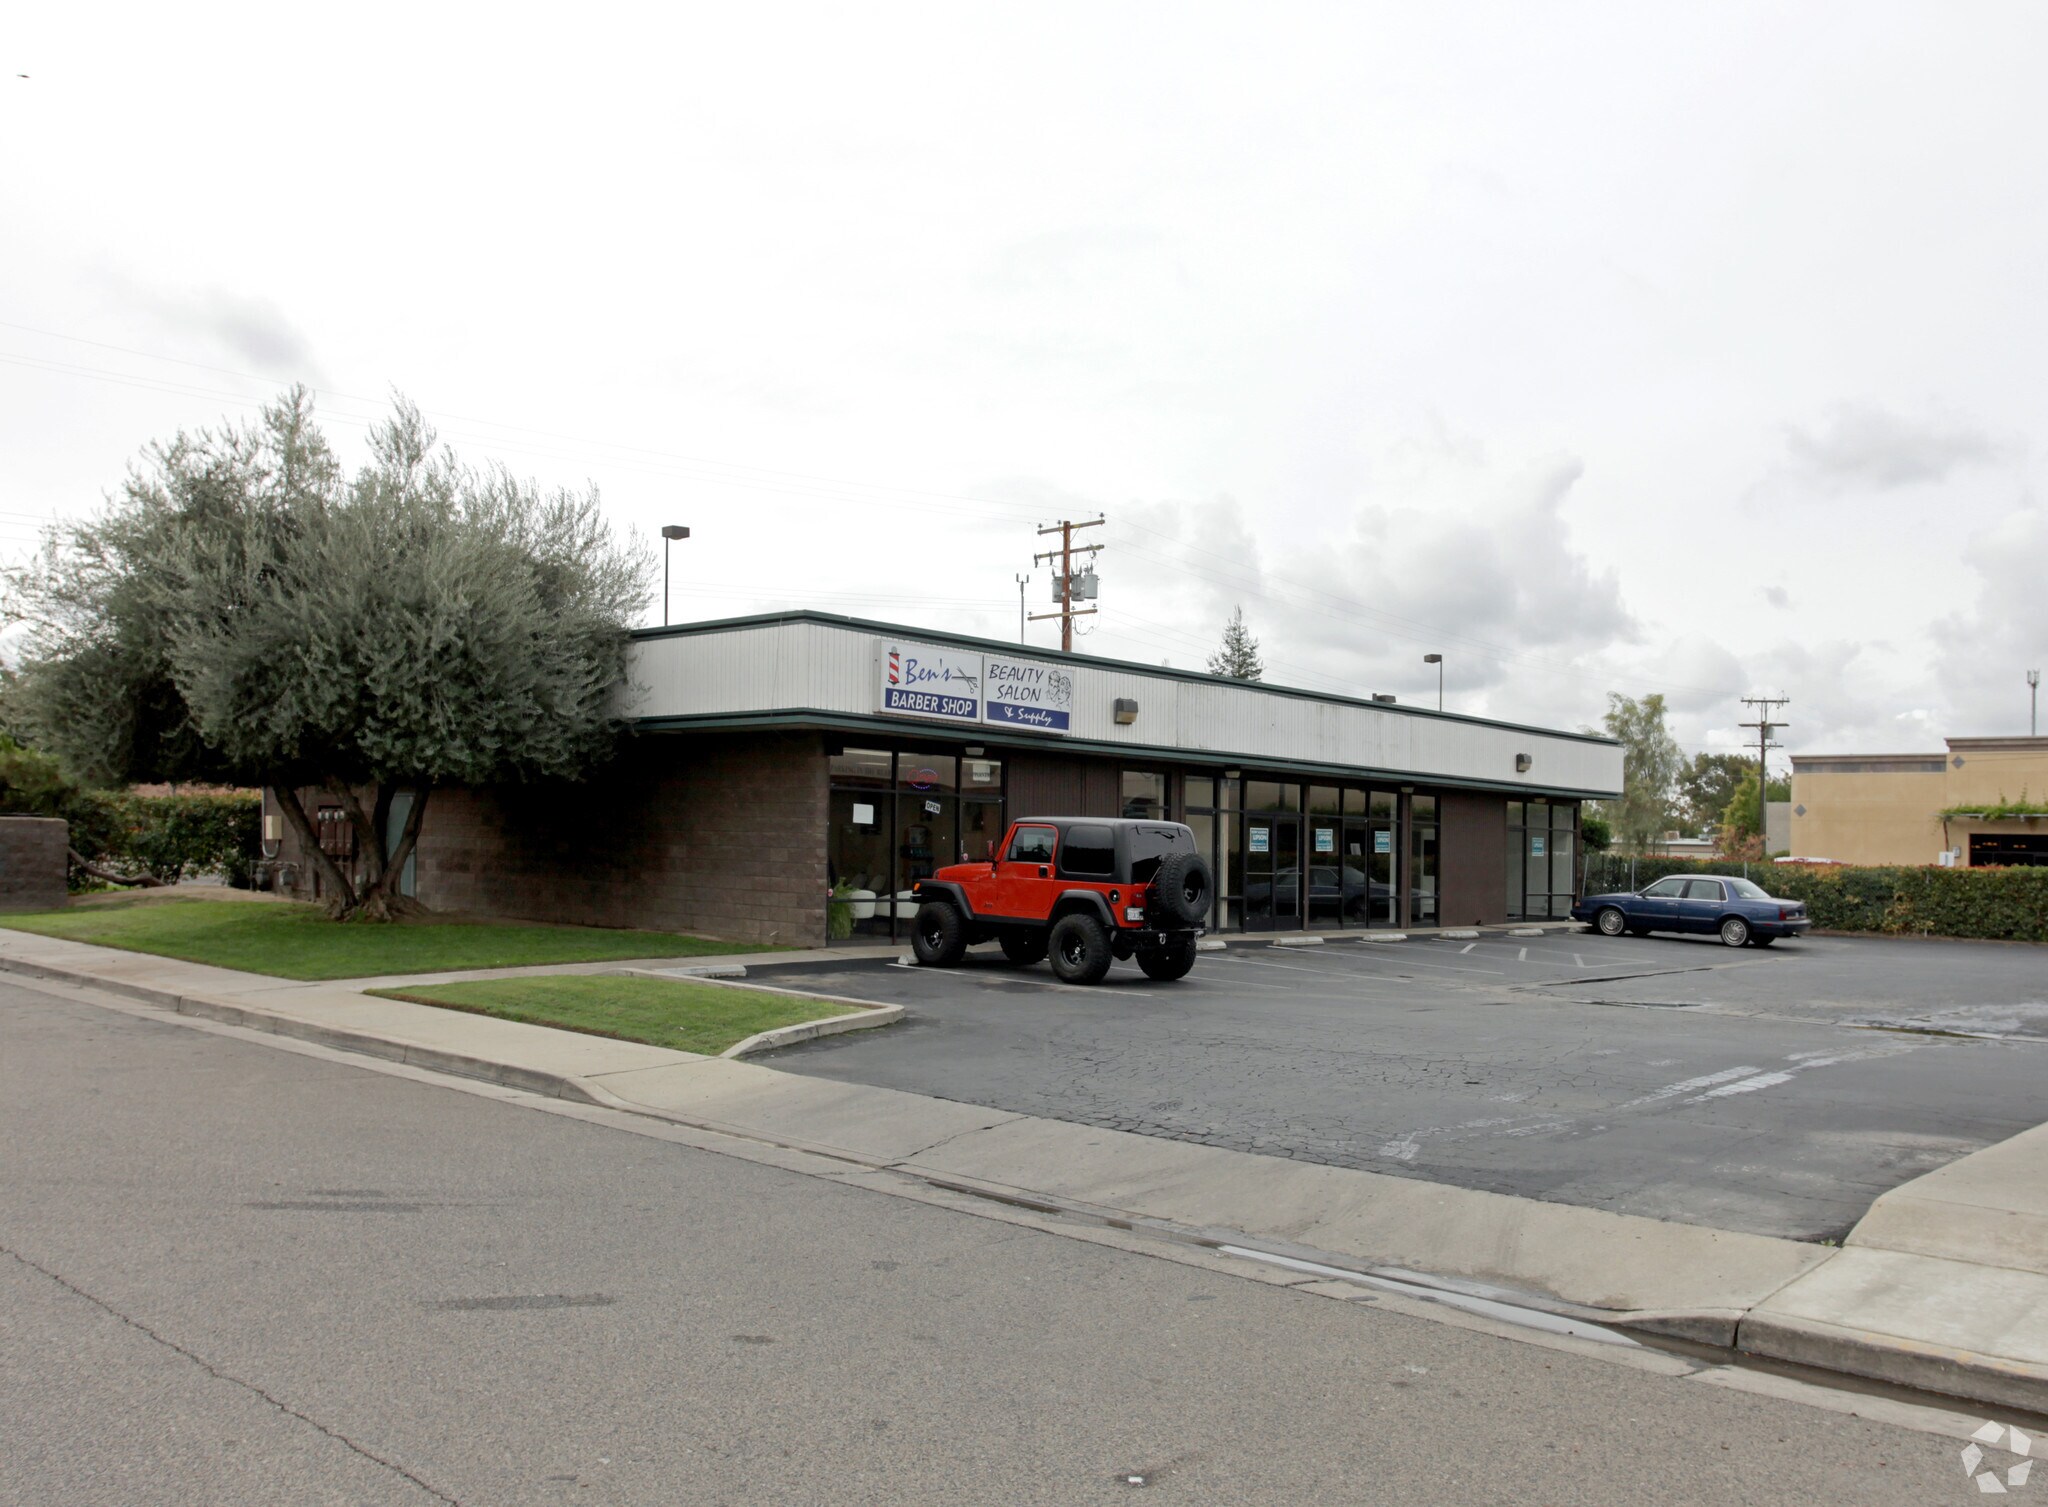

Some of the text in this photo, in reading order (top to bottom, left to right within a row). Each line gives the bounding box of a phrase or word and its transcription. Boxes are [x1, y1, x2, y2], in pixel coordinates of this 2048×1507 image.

[905, 658, 952, 685] Ben's
[988, 663, 1044, 684] BEAUTY
[996, 684, 1043, 702] SALON
[890, 691, 973, 716] BARBER SHOP
[1017, 708, 1053, 726] Supply
[926, 801, 940, 812] OPEN
